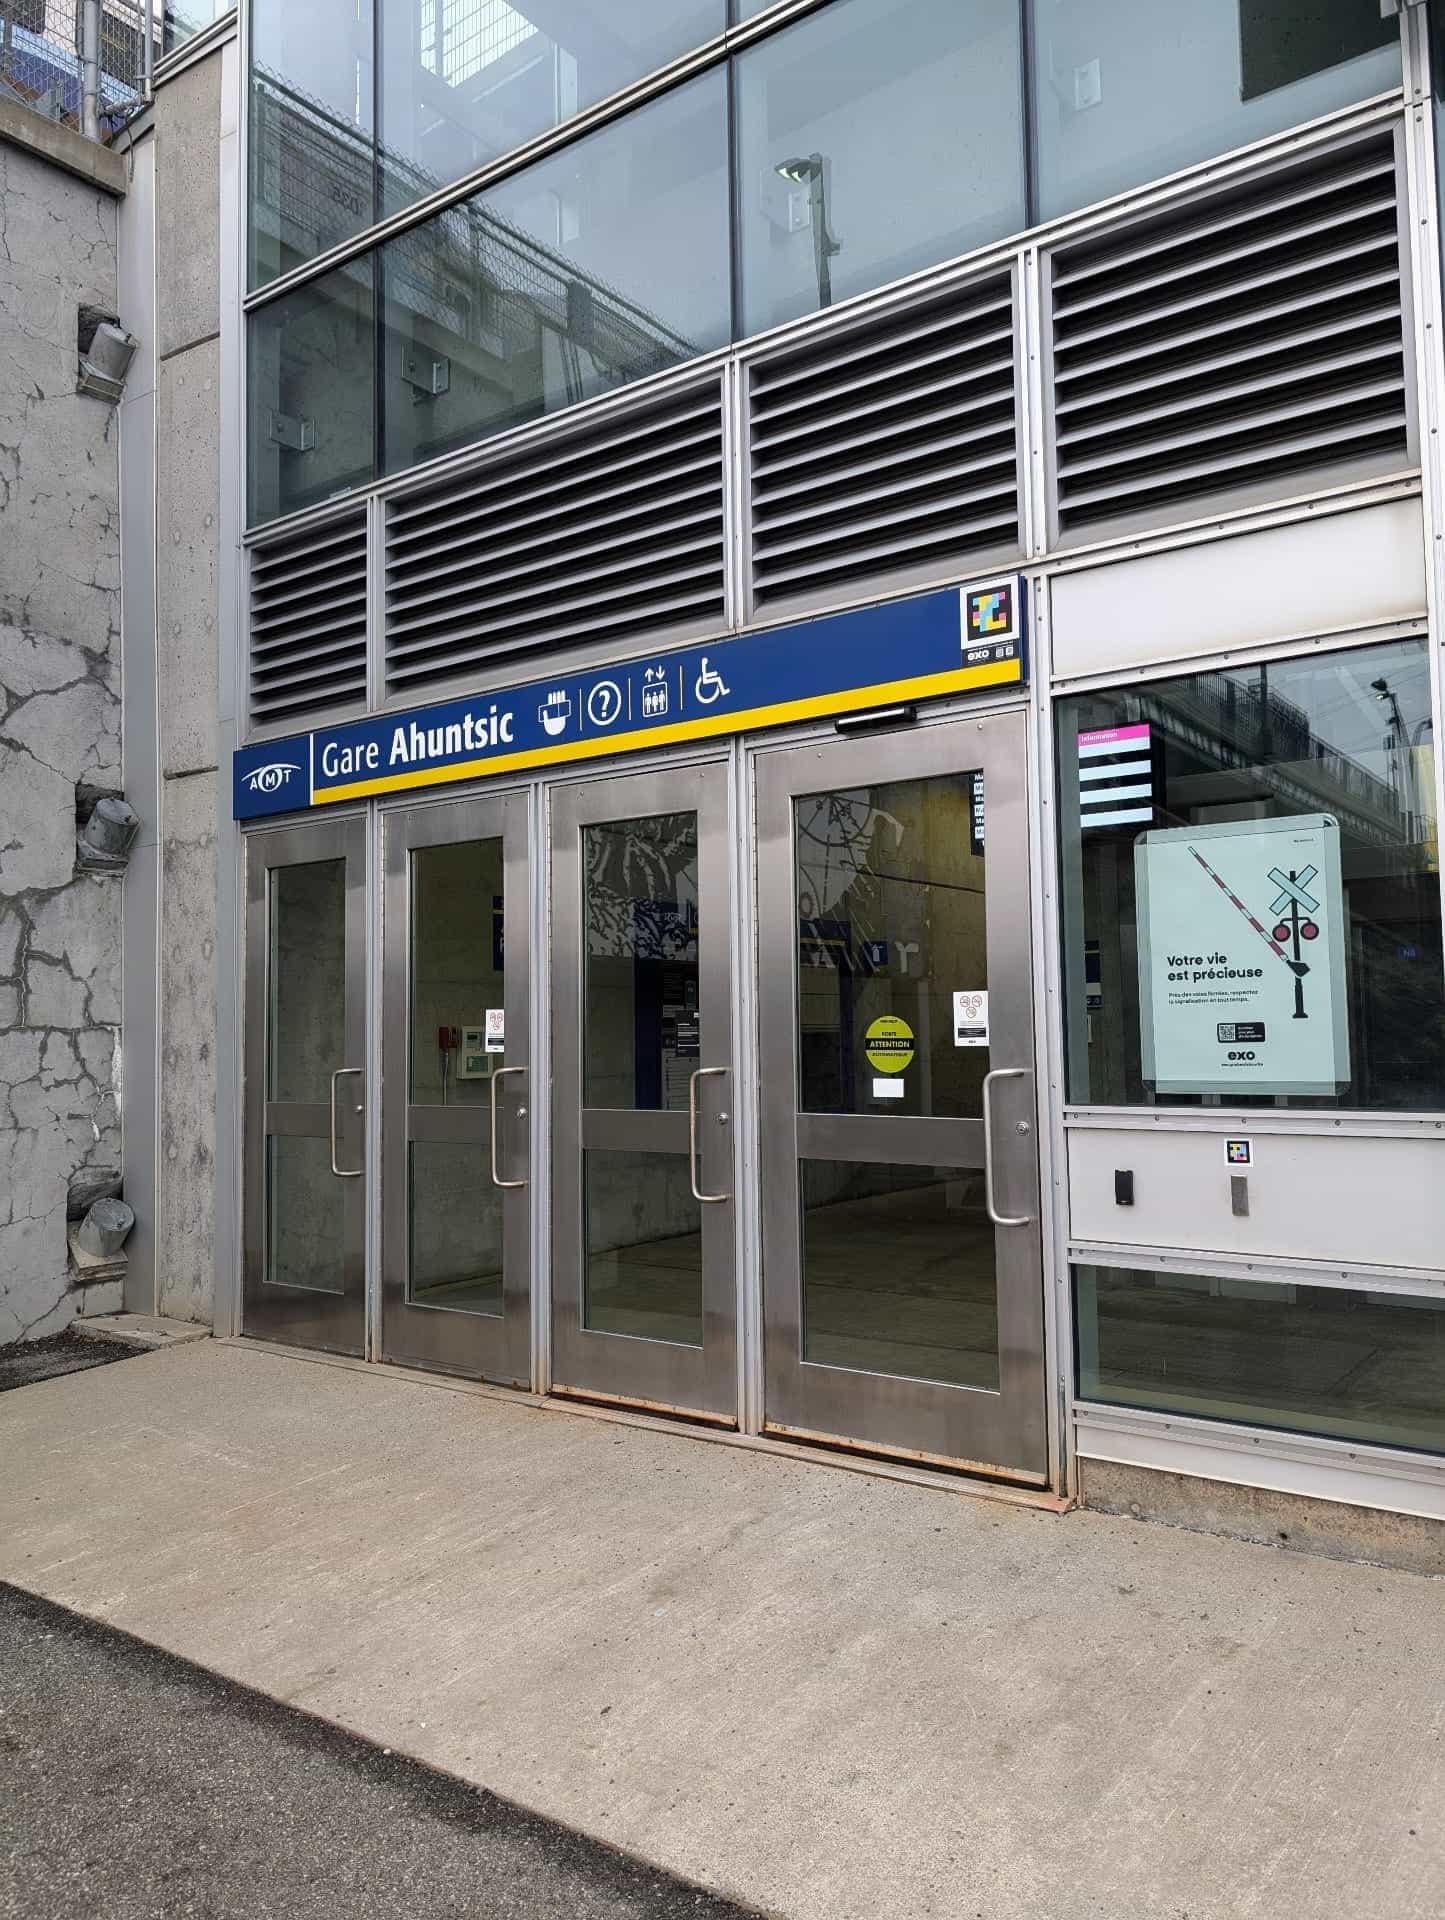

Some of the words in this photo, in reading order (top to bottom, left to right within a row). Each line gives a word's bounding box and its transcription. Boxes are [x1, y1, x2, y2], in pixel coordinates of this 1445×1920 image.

[967, 649, 990, 661] exo
[322, 743, 379, 777] Gare
[389, 704, 513, 766] Ahuntsic
[1081, 731, 1118, 744] Information
[246, 765, 294, 792] AMT
[1167, 956, 1203, 967] Votre
[1207, 952, 1227, 965] vie
[1167, 970, 1189, 981] est
[1193, 966, 1263, 983] précieuse
[869, 1040, 910, 1048] ATTENTION
[1227, 1051, 1256, 1061] exo
